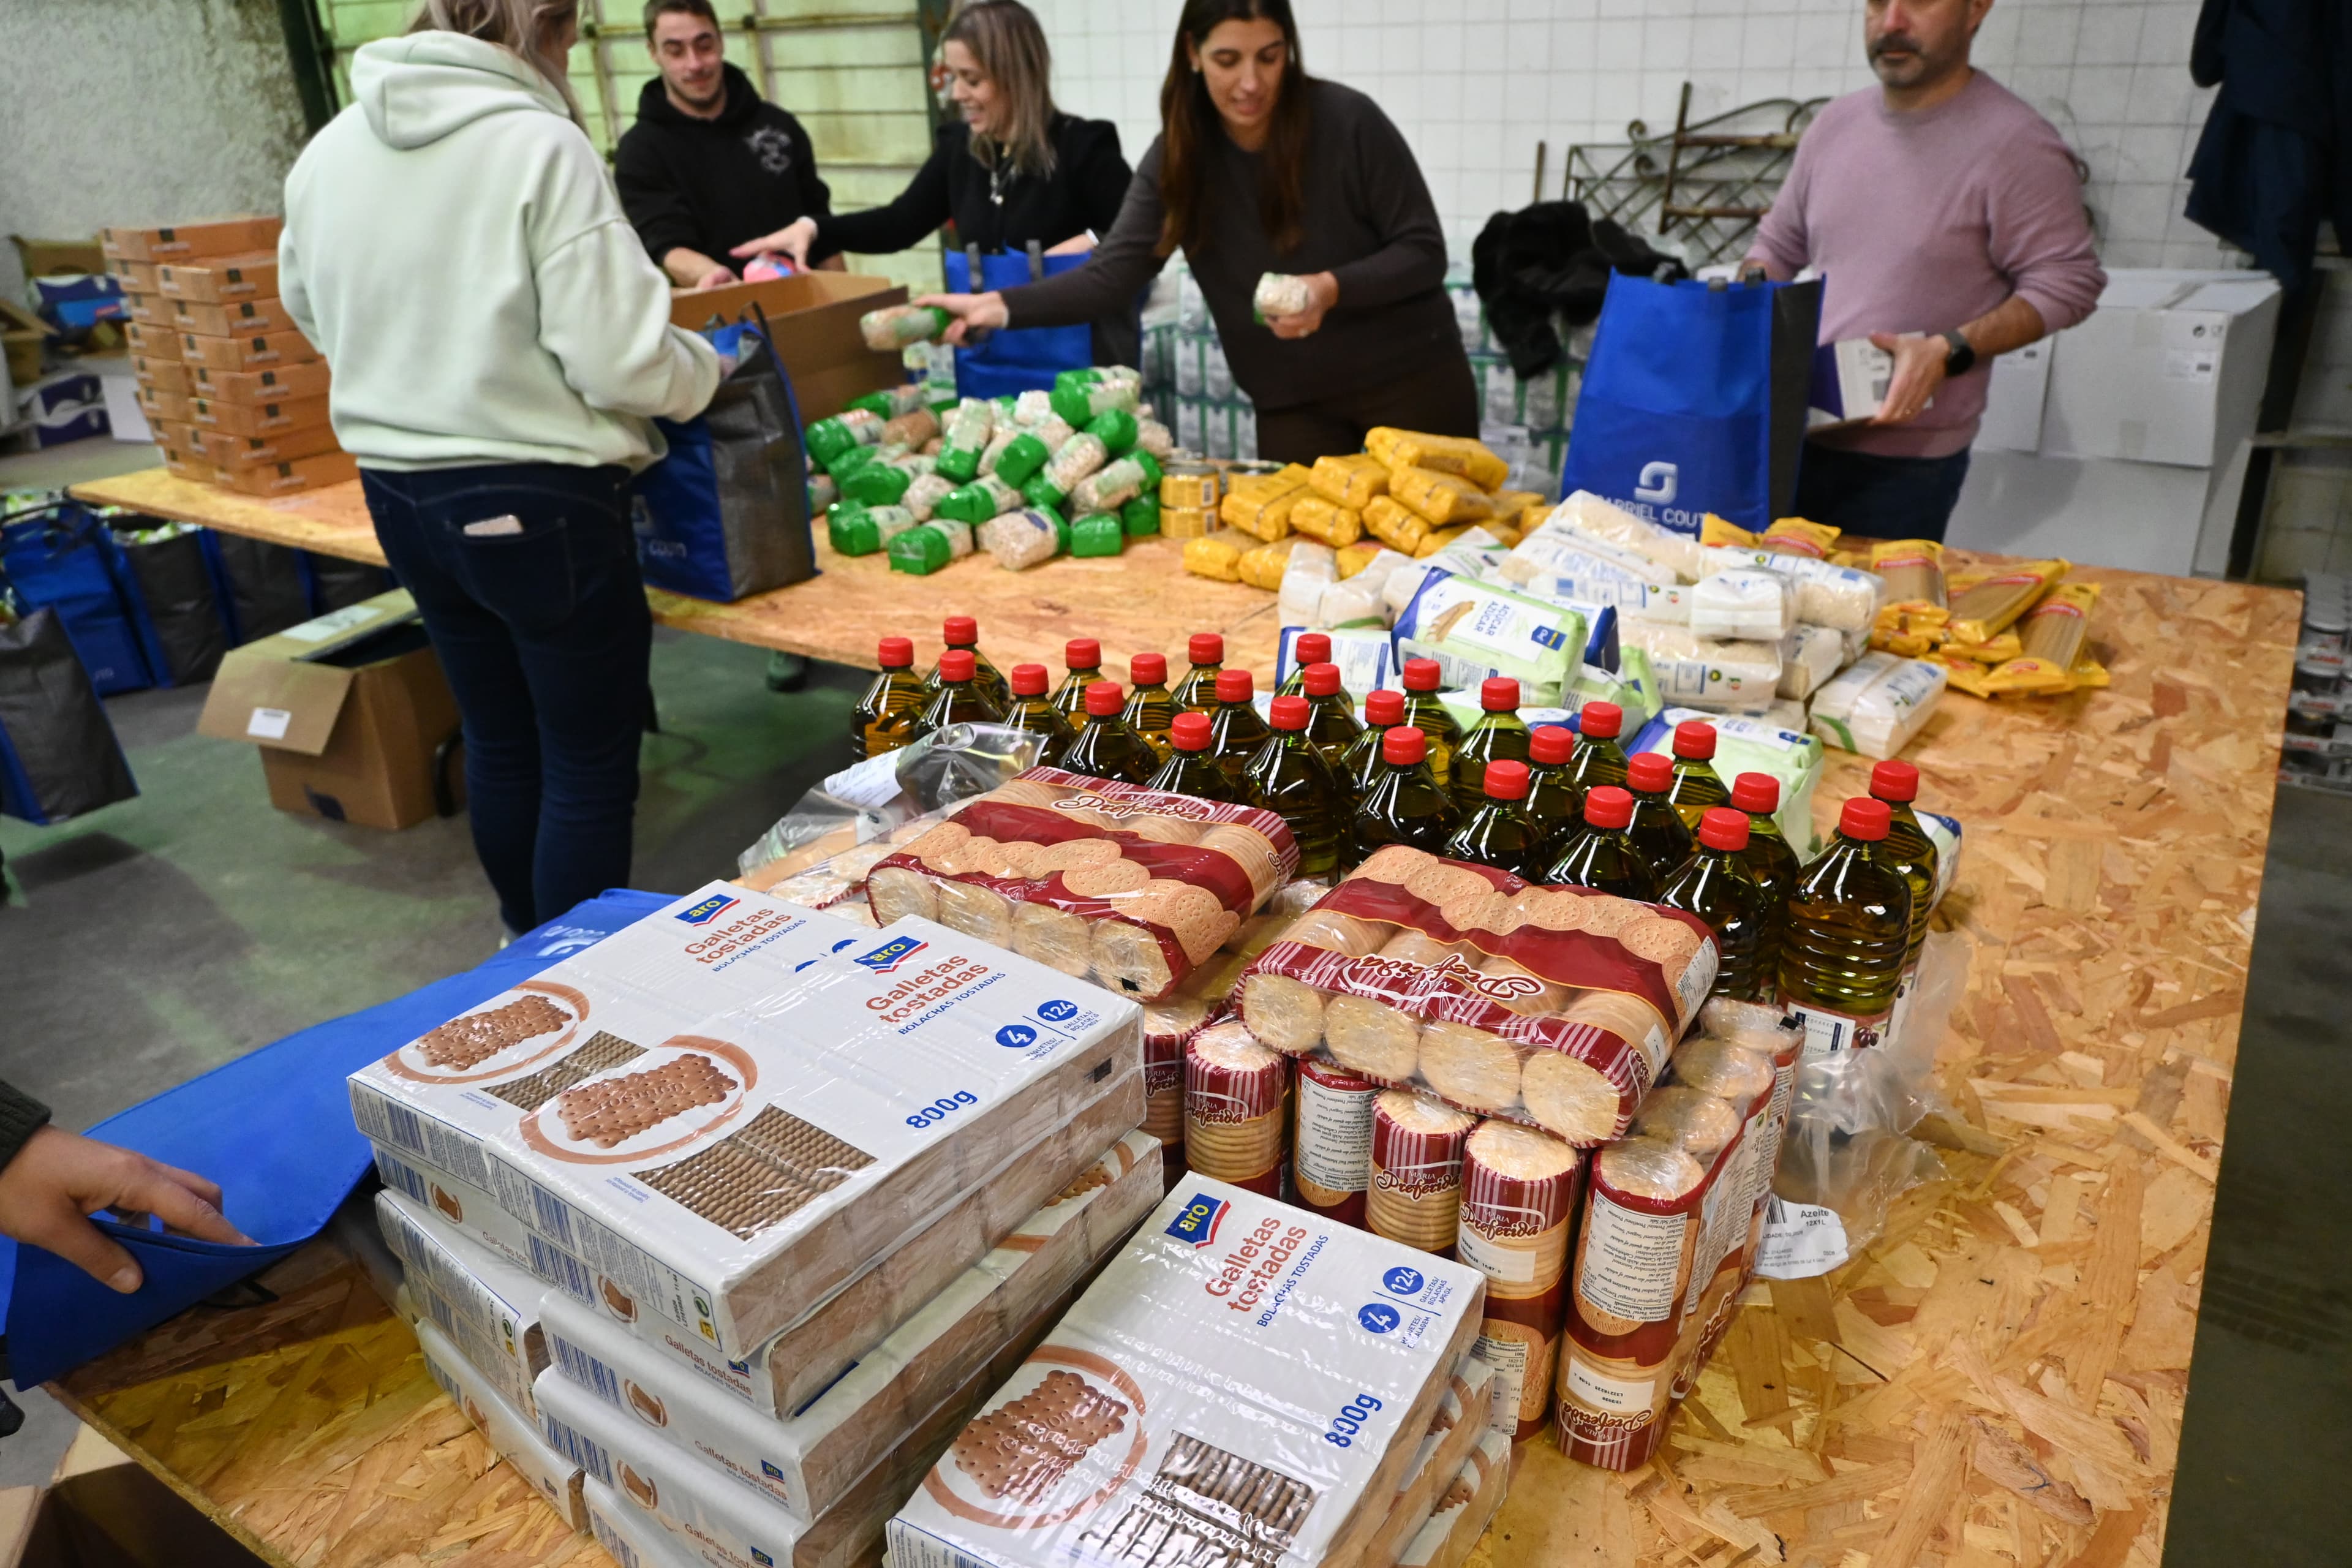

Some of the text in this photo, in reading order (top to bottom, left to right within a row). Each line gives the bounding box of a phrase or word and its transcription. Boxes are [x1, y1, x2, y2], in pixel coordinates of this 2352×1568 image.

[688, 900, 722, 917] aro
[685, 909, 774, 954] Galletas
[696, 914, 791, 963] tostadas
[712, 919, 807, 972] BOLACHAS TOSTADAS
[870, 944, 906, 961] aro
[866, 956, 968, 1010] Galletas
[879, 965, 989, 1023] tostadas
[898, 972, 1006, 1035] BOLACHAS TOSTADAS
[1043, 1001, 1074, 1019] 124
[1006, 1029, 1031, 1044] 4
[906, 1090, 978, 1128] 800g
[1376, 1170, 1460, 1200] Preferida
[1178, 1204, 1209, 1232] aro
[1460, 1202, 1540, 1242] Preferida
[1484, 1209, 1510, 1223] MARIA
[1801, 1209, 1829, 1218] Azeite
[1205, 1218, 1281, 1297] Galletas
[1227, 1226, 1307, 1312] tostadas
[1291, 1235, 1329, 1277] TOSTADAS
[1391, 1269, 1418, 1291] 124
[1420, 1276, 1440, 1303] GALLETAS/
[1428, 1280, 1447, 1305] BOLACHAS
[1368, 1311, 1392, 1327] 4
[1607, 1308, 1635, 1319] Informação
[665, 1335, 752, 1395] Galletas tostadas
[1324, 1393, 1382, 1447] 800g
[1562, 1401, 1653, 1433] Preferida
[1585, 1427, 1611, 1441] MARIA
[695, 1440, 787, 1500] Galletas tostadas
[767, 1465, 778, 1476] aro
[685, 1523, 727, 1555] Galletas
[755, 1551, 769, 1562] aro
